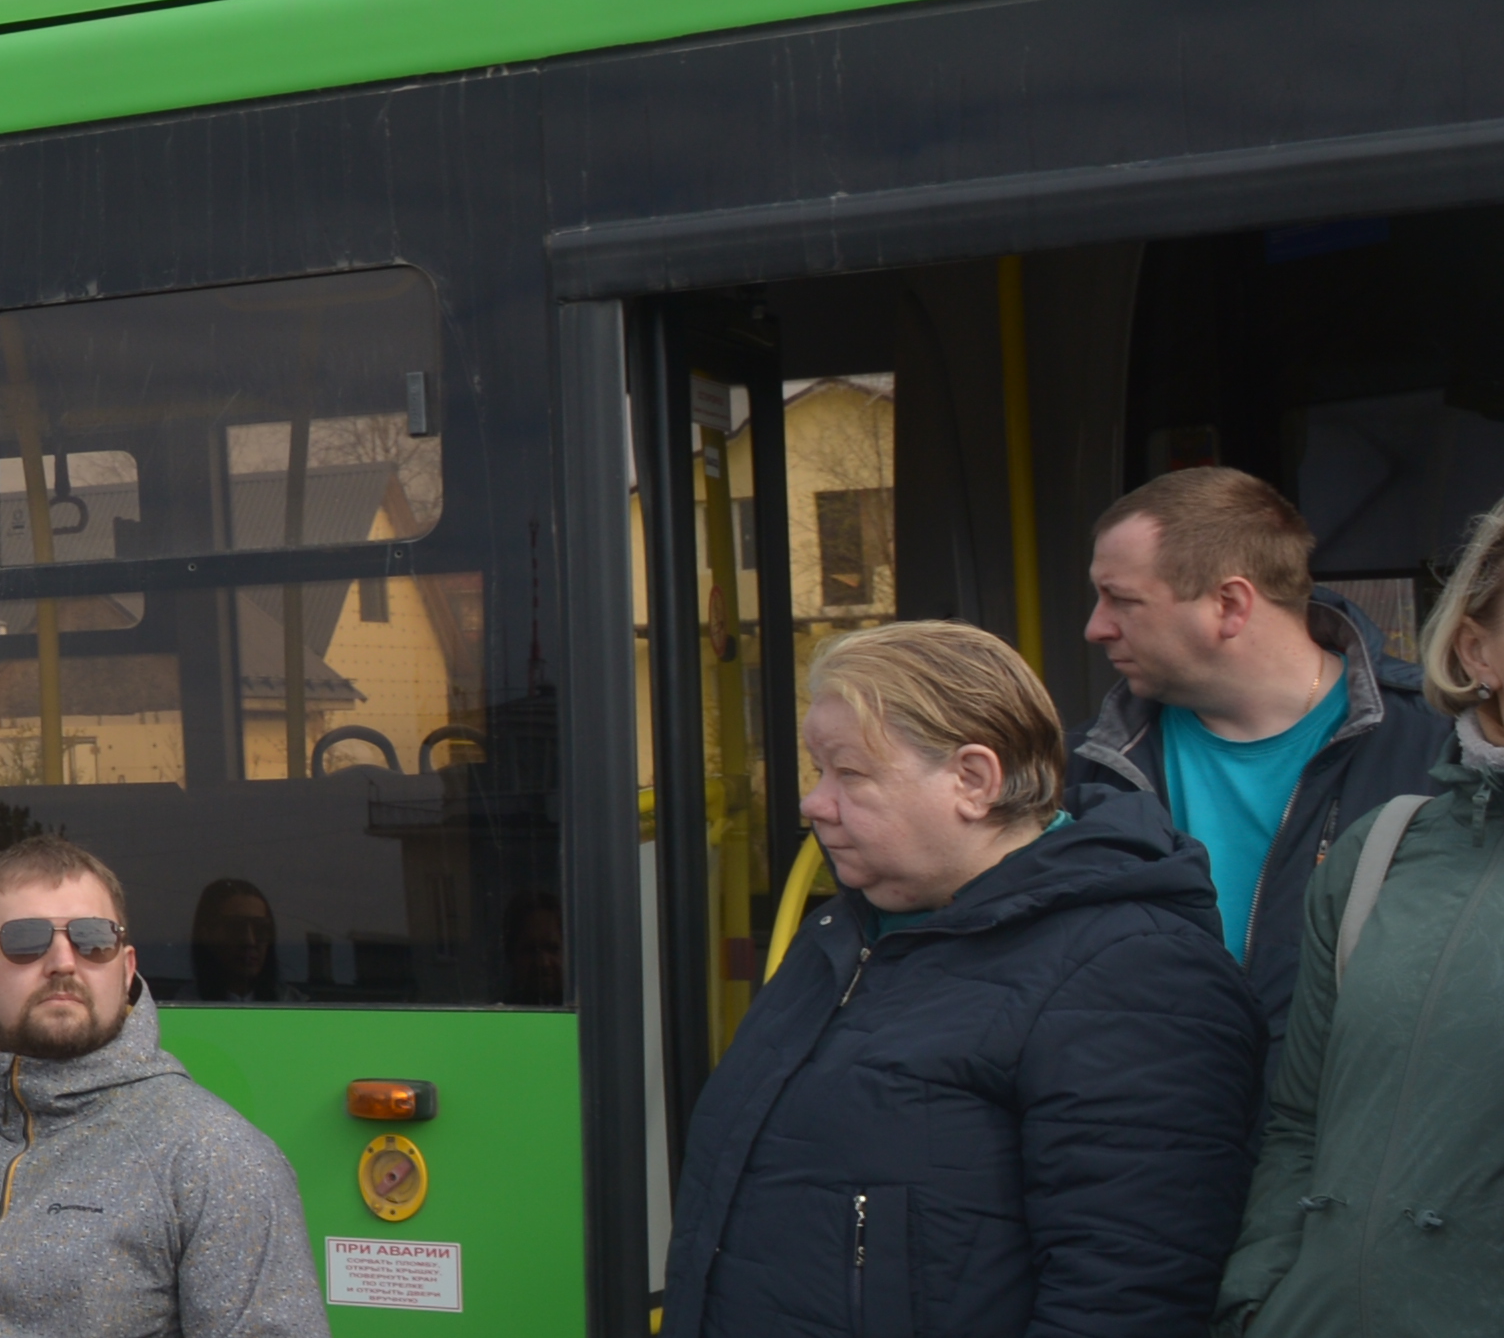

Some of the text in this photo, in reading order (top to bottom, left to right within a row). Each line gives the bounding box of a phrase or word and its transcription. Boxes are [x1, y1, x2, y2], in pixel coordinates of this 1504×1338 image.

[335, 1242, 451, 1259] ПРИ АВАРИИ
[346, 1257, 393, 1265] СОРВАТЬ
[345, 1265, 393, 1273] ОТКРЫТЬ
[349, 1272, 409, 1281] ПОВЕРНУТЬ
[379, 1282, 424, 1290] СТРЕЛКЕ
[356, 1288, 404, 1296] ОТКРЫТЬ
[368, 1295, 419, 1304] ВРУЧНУЮ
